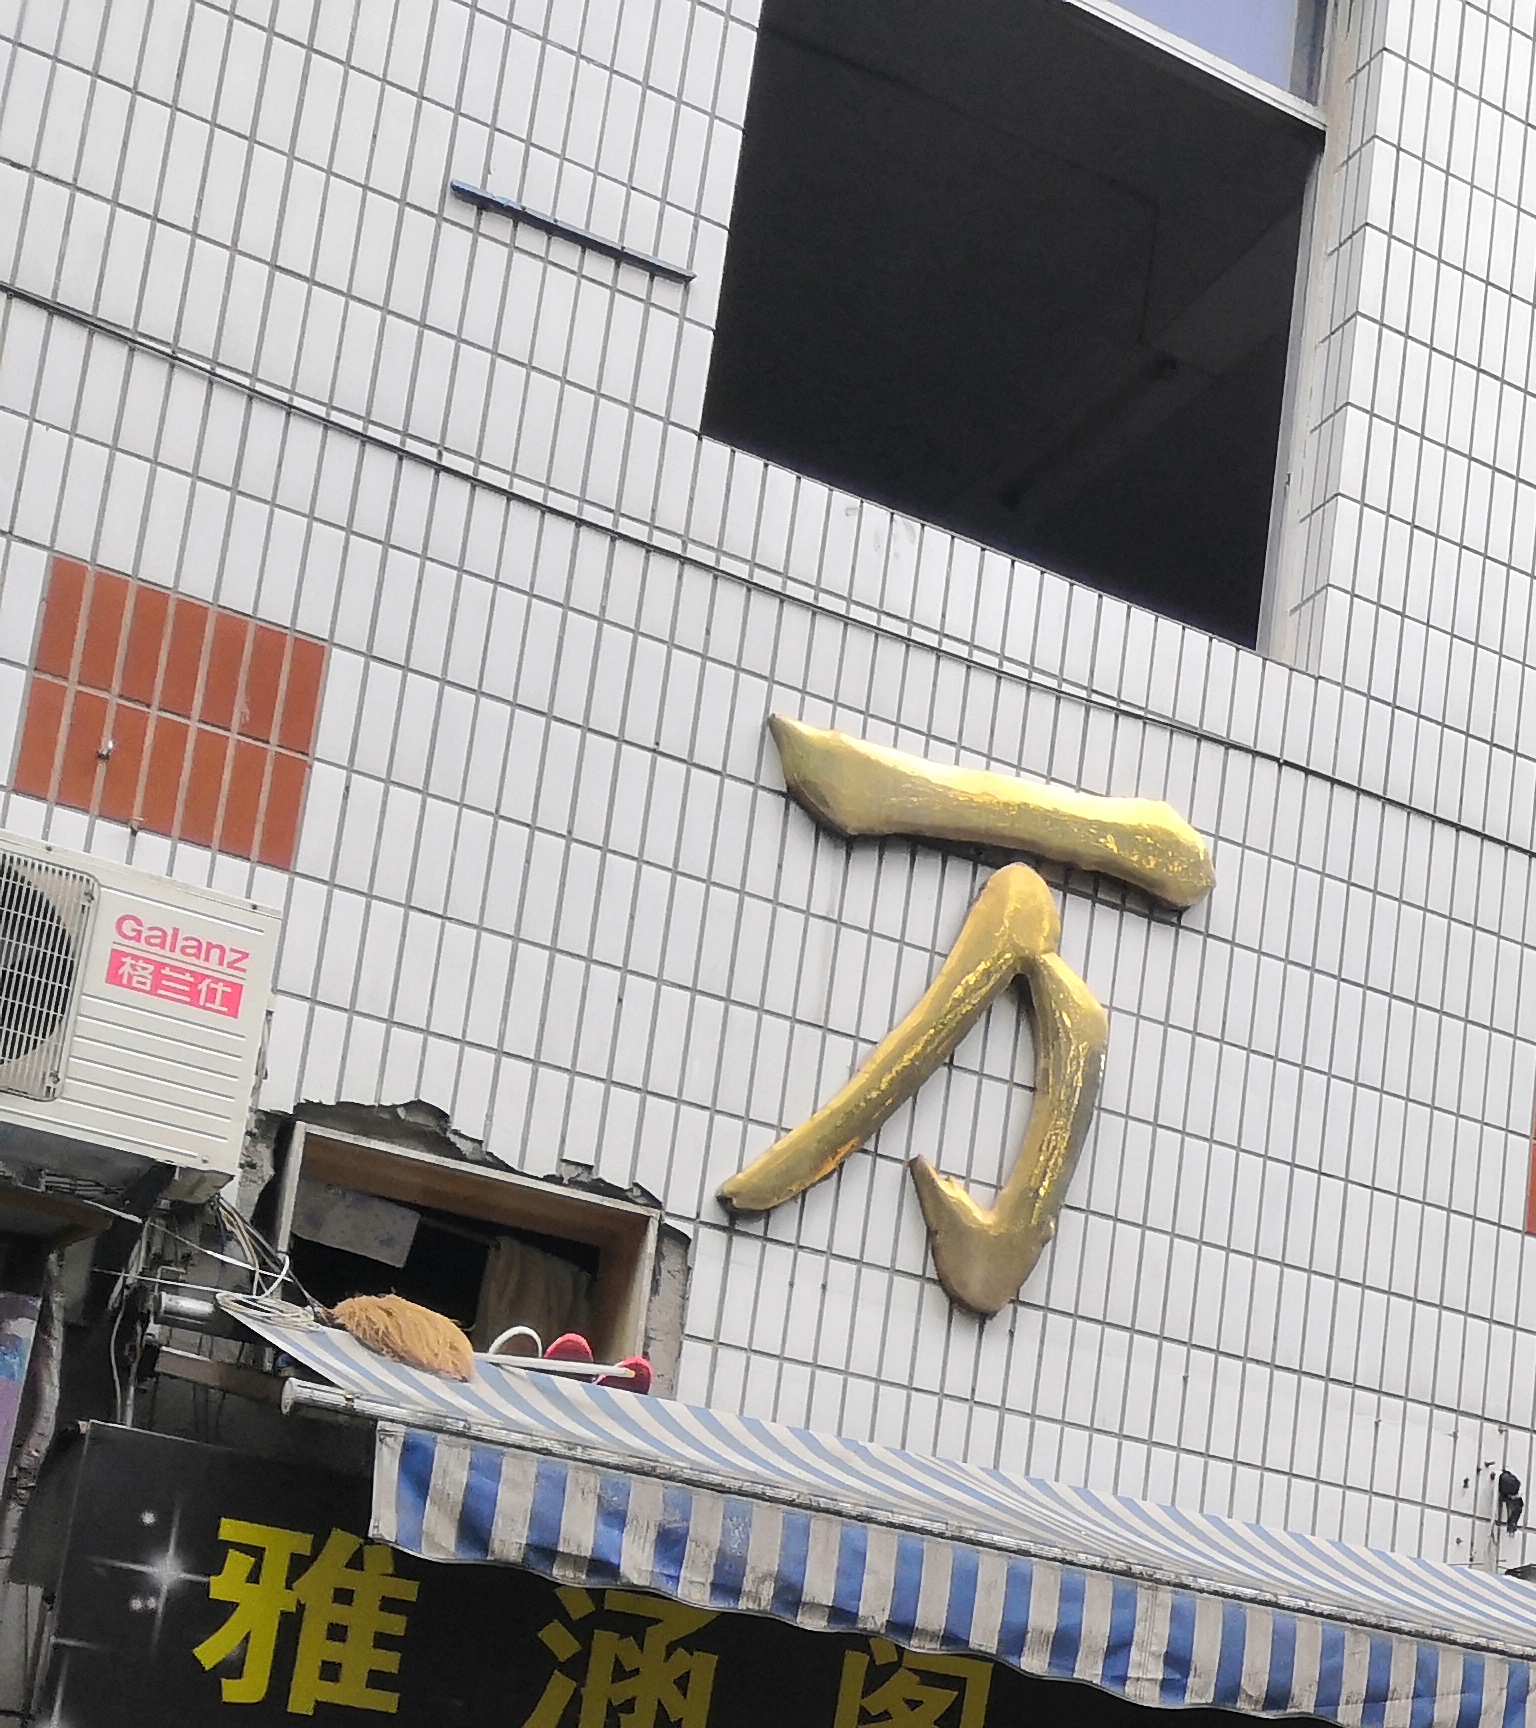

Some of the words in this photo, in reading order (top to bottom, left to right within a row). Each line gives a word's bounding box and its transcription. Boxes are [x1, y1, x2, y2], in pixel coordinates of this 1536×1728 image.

[115, 914, 250, 974] Galanz
[117, 955, 233, 1012] 格兰仕
